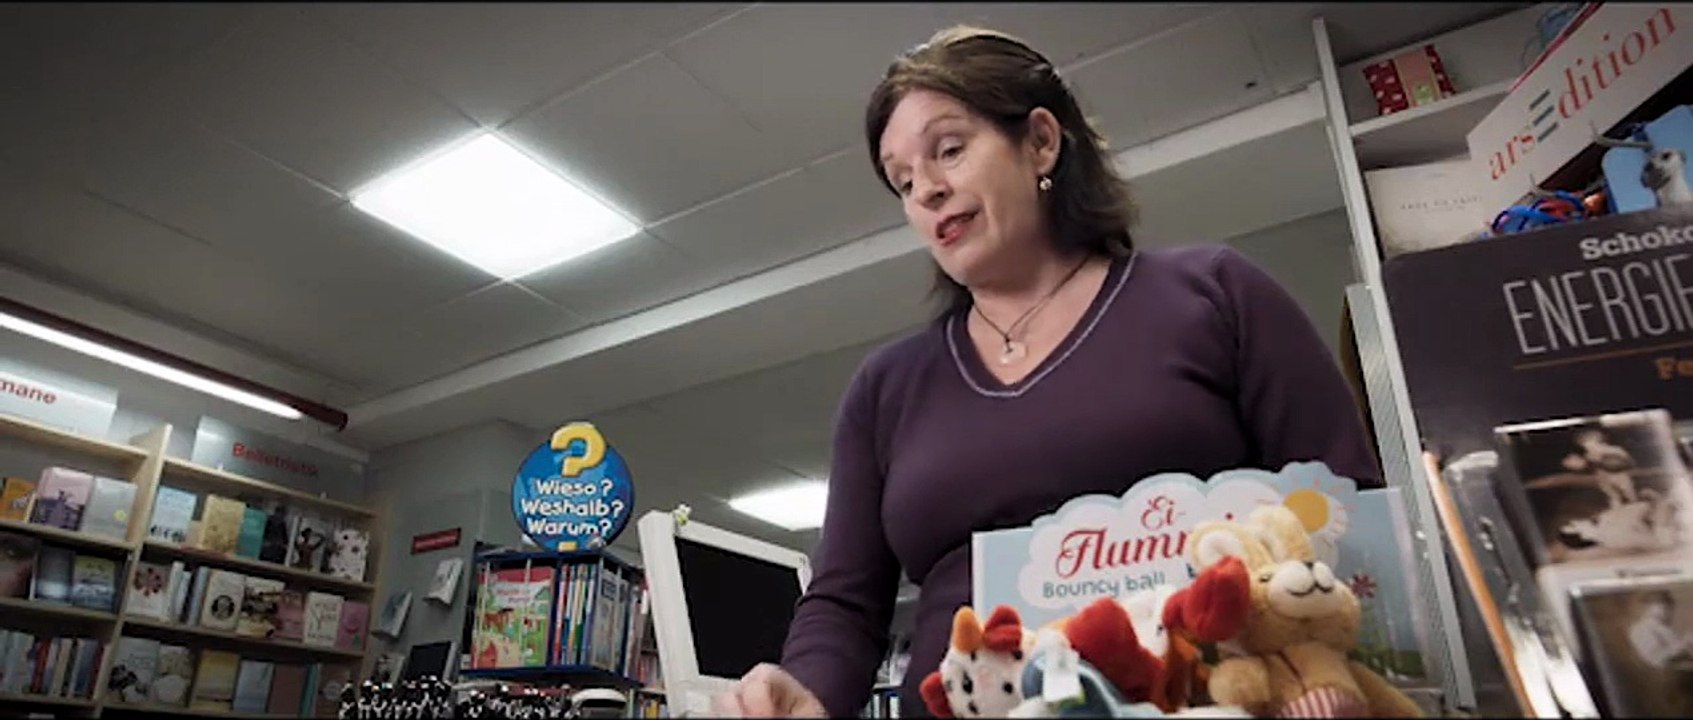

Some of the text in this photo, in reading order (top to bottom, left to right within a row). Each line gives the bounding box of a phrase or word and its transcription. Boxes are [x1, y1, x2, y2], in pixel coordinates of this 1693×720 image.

[521, 498, 625, 518] Weshalb?
[526, 517, 613, 538] Warum?
[1042, 570, 1166, 600] Bouncy ball
